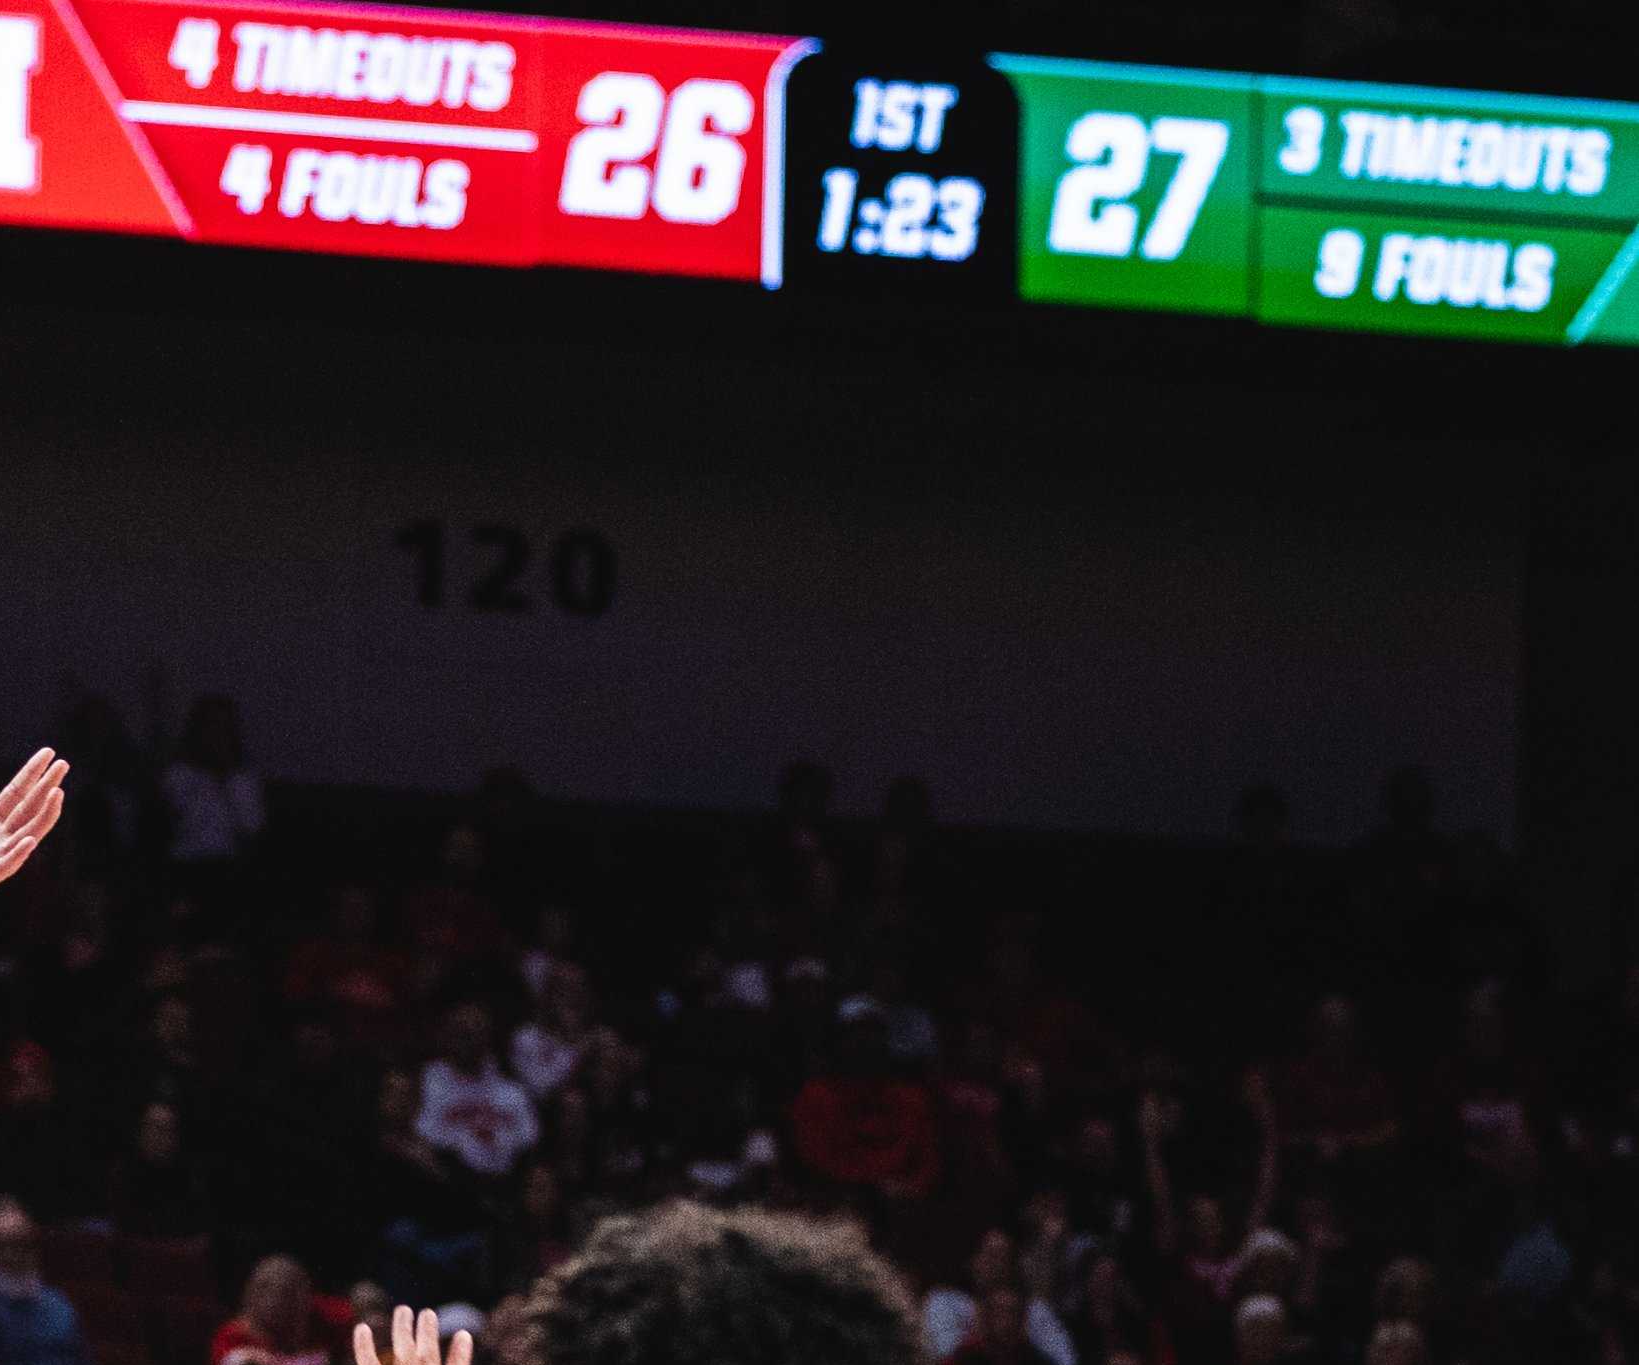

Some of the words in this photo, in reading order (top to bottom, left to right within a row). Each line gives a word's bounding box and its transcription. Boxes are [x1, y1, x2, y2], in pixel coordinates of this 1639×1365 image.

[168, 17, 219, 87] 4
[231, 22, 516, 110] TIMEOUTS
[559, 70, 756, 225] 26
[850, 79, 958, 154] 1ST
[1278, 105, 1324, 176] 3
[1340, 110, 1612, 196] TIMEOUTS
[221, 143, 272, 215] 4
[278, 150, 471, 231] FOULS
[816, 167, 984, 262] 1:23
[1047, 110, 1230, 261] 27
[1314, 229, 1363, 299] 9
[1372, 233, 1556, 313] FOULS
[395, 522, 618, 614] 120
